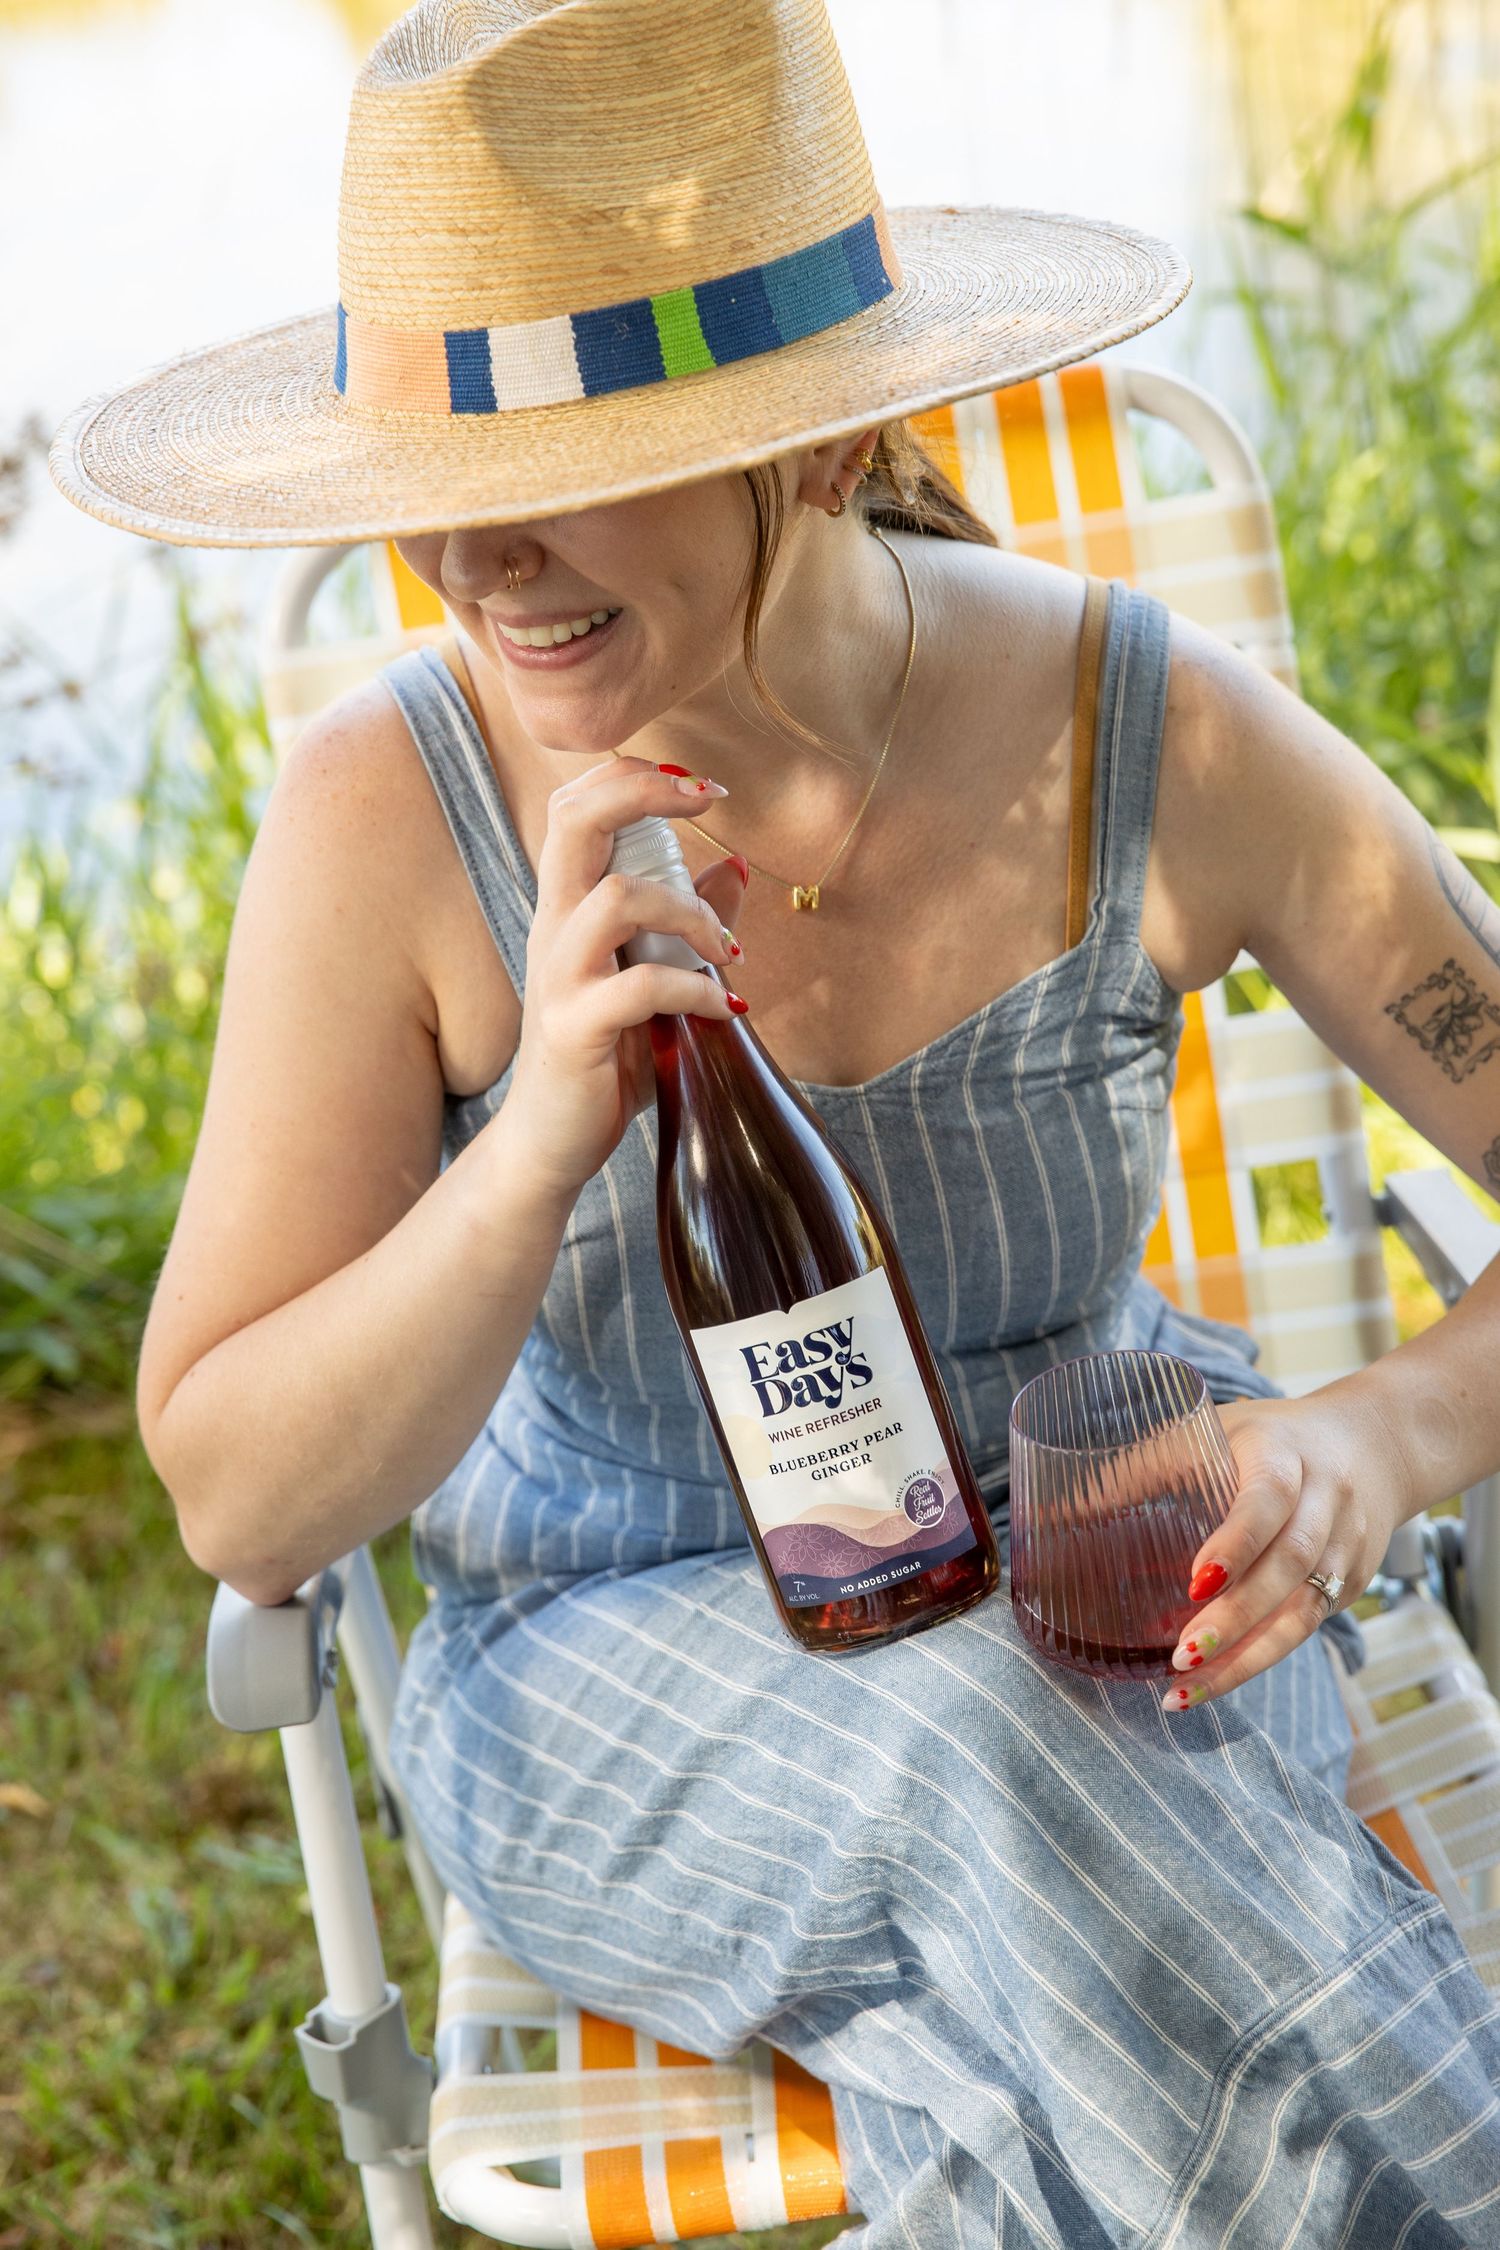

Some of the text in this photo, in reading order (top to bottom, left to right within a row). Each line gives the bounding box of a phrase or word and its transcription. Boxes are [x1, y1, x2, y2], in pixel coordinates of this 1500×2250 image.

[739, 1317, 854, 1382] Easy
[752, 1353, 873, 1417] Days
[768, 1398, 882, 1444] WINE REFRESHER
[769, 1422, 903, 1475] BLUEBERRY PEAR
[811, 1453, 872, 1480] GINGER
[910, 1480, 930, 1498] Real
[913, 1493, 935, 1511] Fruit
[915, 1505, 942, 1524] Settles
[840, 1561, 921, 1594] NO ADDED SUGAR
